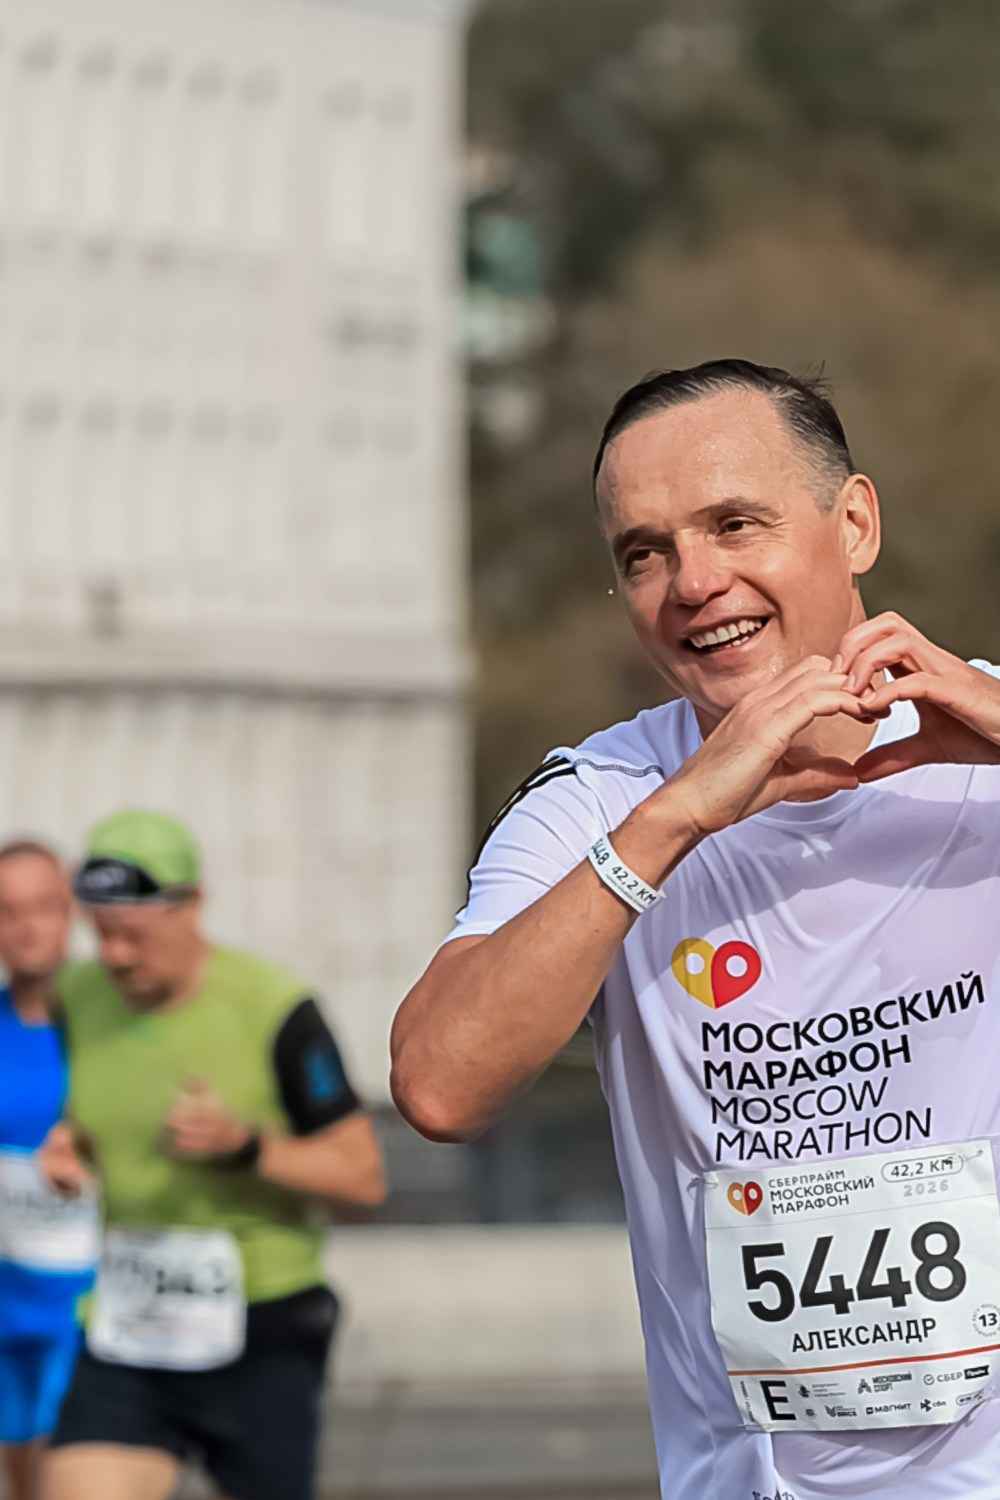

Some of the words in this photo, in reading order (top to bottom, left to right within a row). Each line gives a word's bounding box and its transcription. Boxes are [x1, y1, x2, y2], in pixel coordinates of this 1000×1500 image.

[612, 866, 639, 890] 42,2
[701, 970, 985, 1053] МОСКОВСКИЙ
[703, 1034, 911, 1090] МАРАФОН
[711, 1077, 889, 1125] MOSCOW
[715, 1107, 932, 1162] MARATHON
[768, 1169, 845, 1188] СБЕРПРАЙМ
[890, 1163, 924, 1177] 42,2
[770, 1176, 875, 1201] МОСКОВСКИЙ
[903, 1179, 949, 1197] 2026
[772, 1194, 850, 1215] МАРАФОН
[741, 1221, 967, 1323] 5448
[978, 1313, 998, 1327] 13
[792, 1317, 937, 1353] АЛЕКСАНДР
[937, 1372, 962, 1383] СБЕР
[760, 1380, 797, 1420] E
